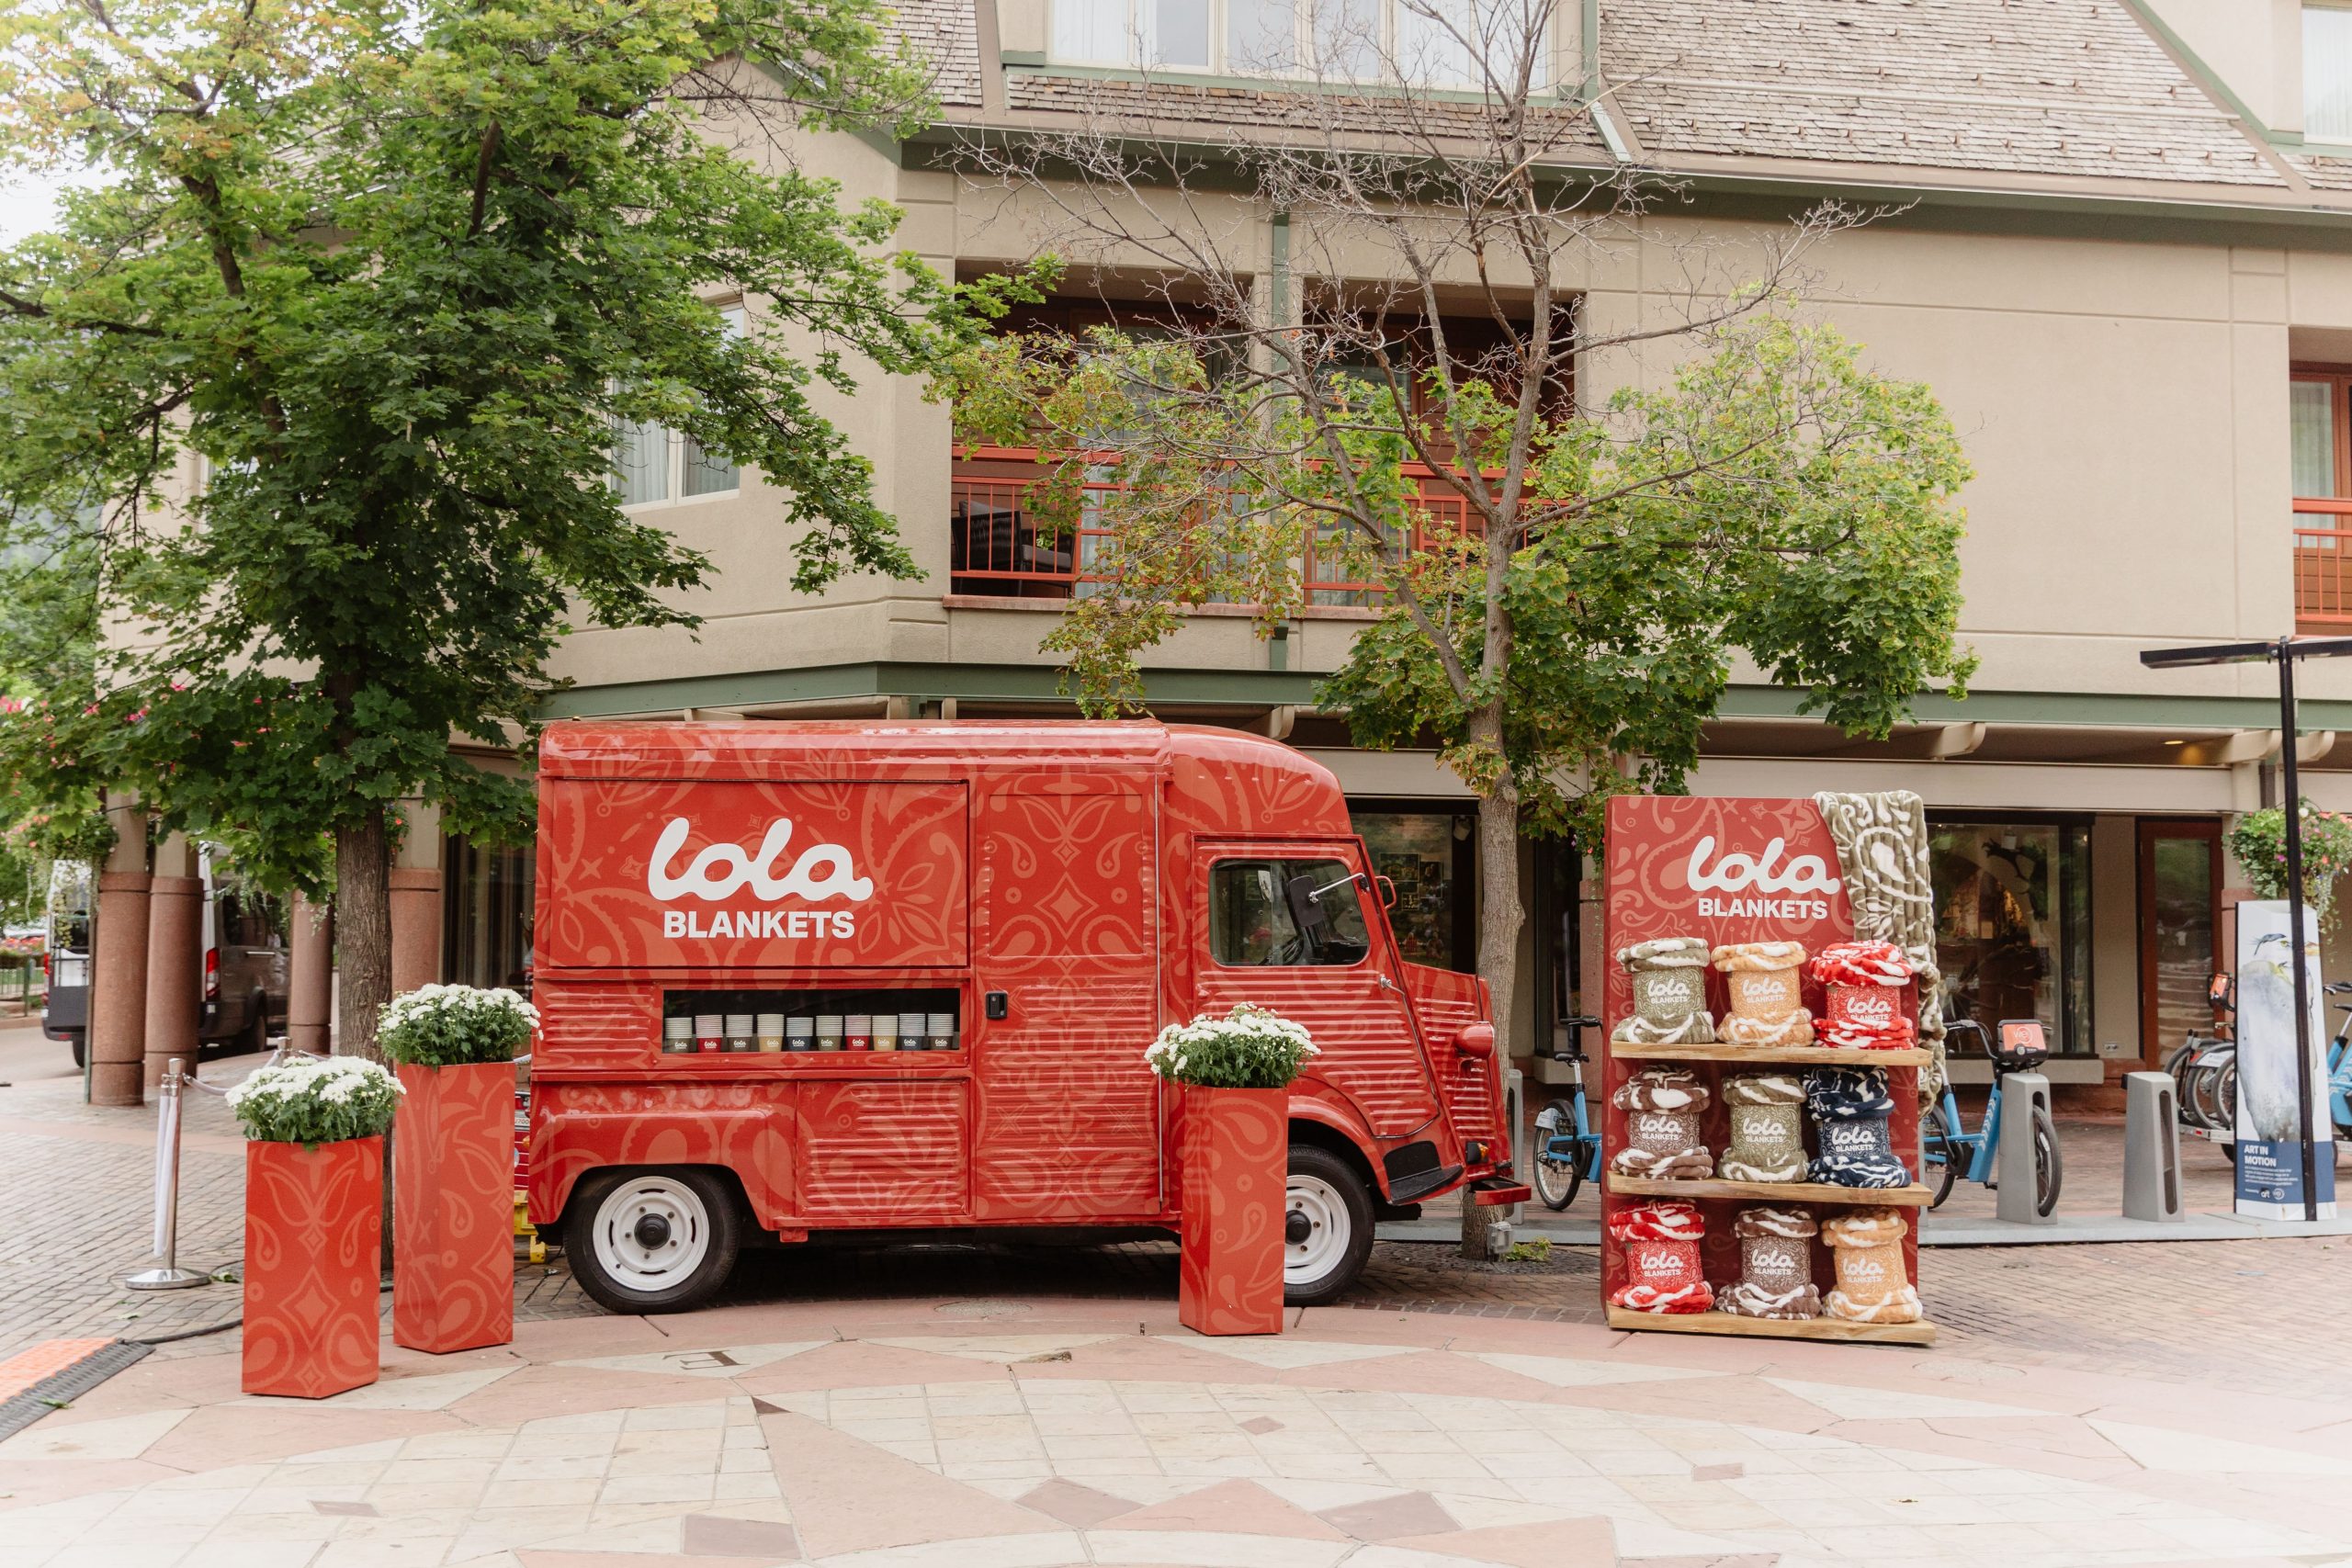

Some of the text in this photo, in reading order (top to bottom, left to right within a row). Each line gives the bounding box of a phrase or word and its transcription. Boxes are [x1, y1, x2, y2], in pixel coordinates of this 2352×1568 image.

[1698, 898, 1827, 919] BLANKETS
[663, 910, 855, 939] BLANKETS
[1642, 1133, 1679, 1141] BLANKETS
[2244, 1145, 2268, 1156] ART IN
[2245, 1156, 2277, 1167] MOTION
[1644, 1268, 1681, 1277] BLANKETS
[1754, 1267, 1792, 1276] BLANKETS
